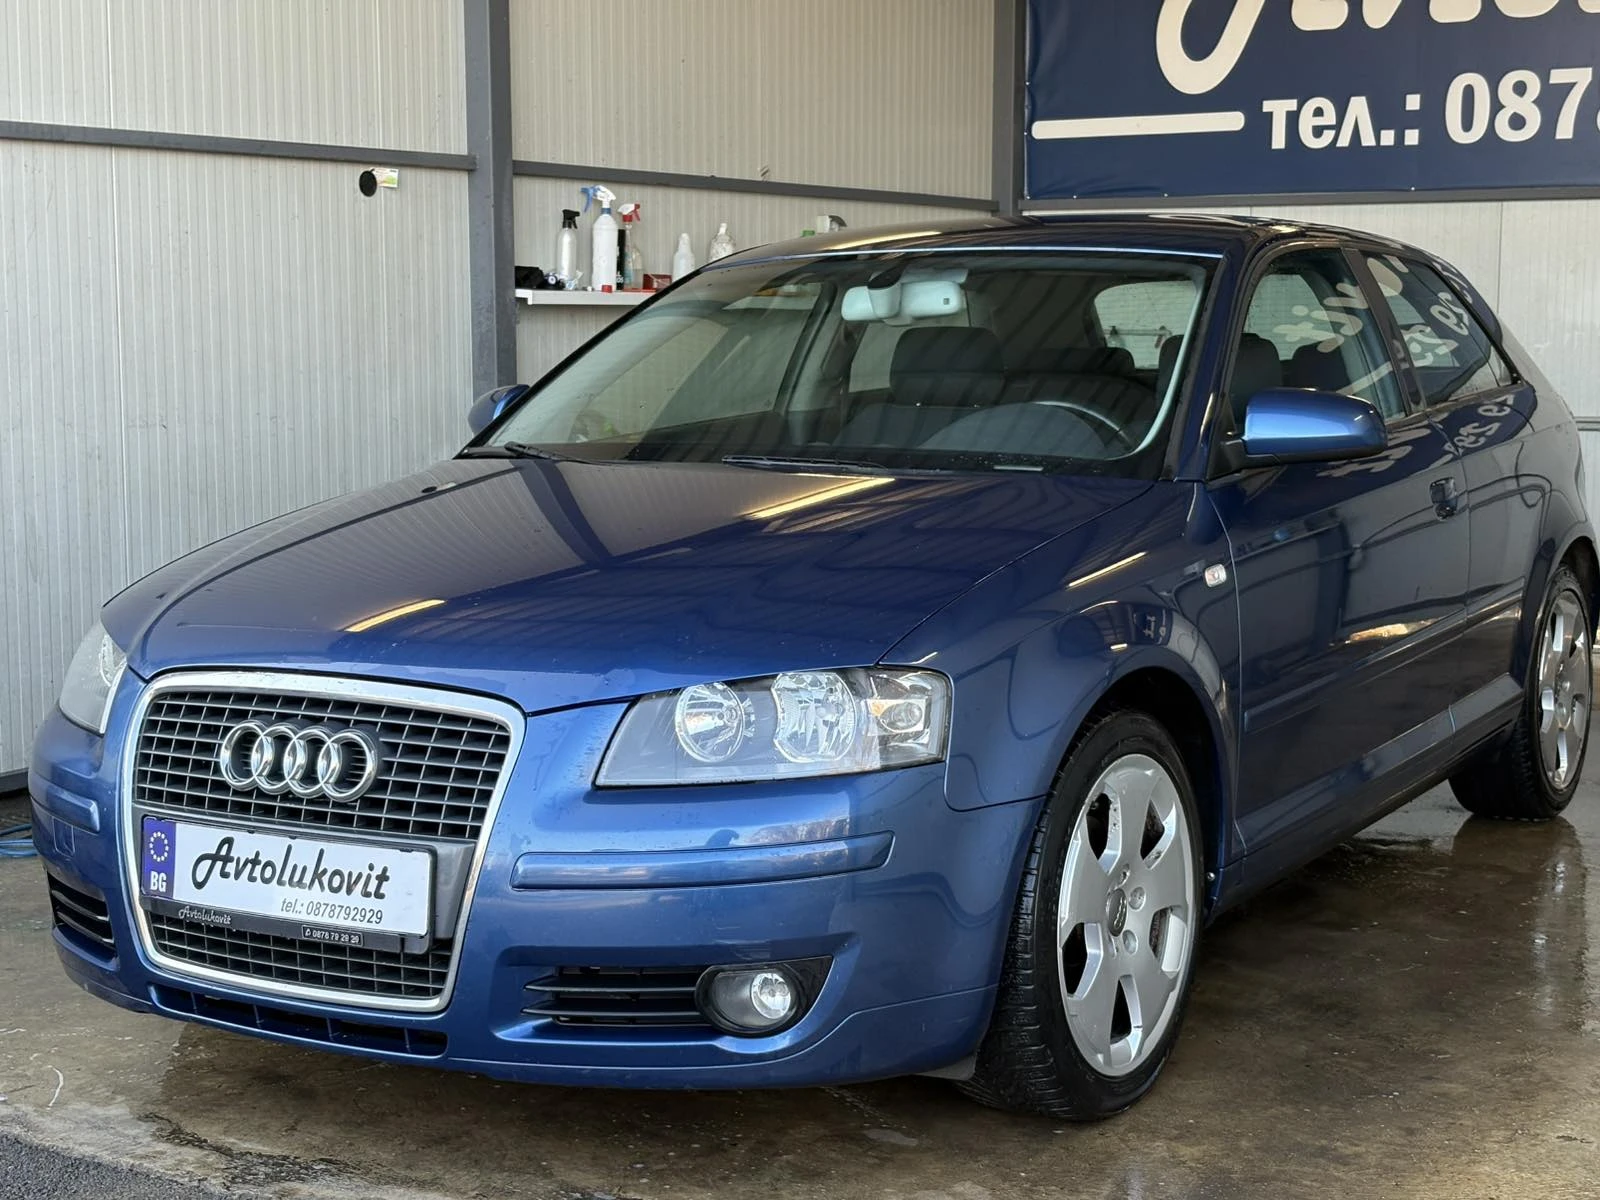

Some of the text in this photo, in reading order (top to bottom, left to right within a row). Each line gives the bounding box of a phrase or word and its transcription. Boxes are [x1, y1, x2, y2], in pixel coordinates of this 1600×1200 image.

[1445, 67, 1600, 144] 087
[192, 836, 390, 899] Avtolukovit
[150, 871, 167, 892] BG
[178, 905, 232, 925] Avtolukovit
[281, 898, 383, 925] tel.: 0878792929
[312, 929, 330, 940] 0878
